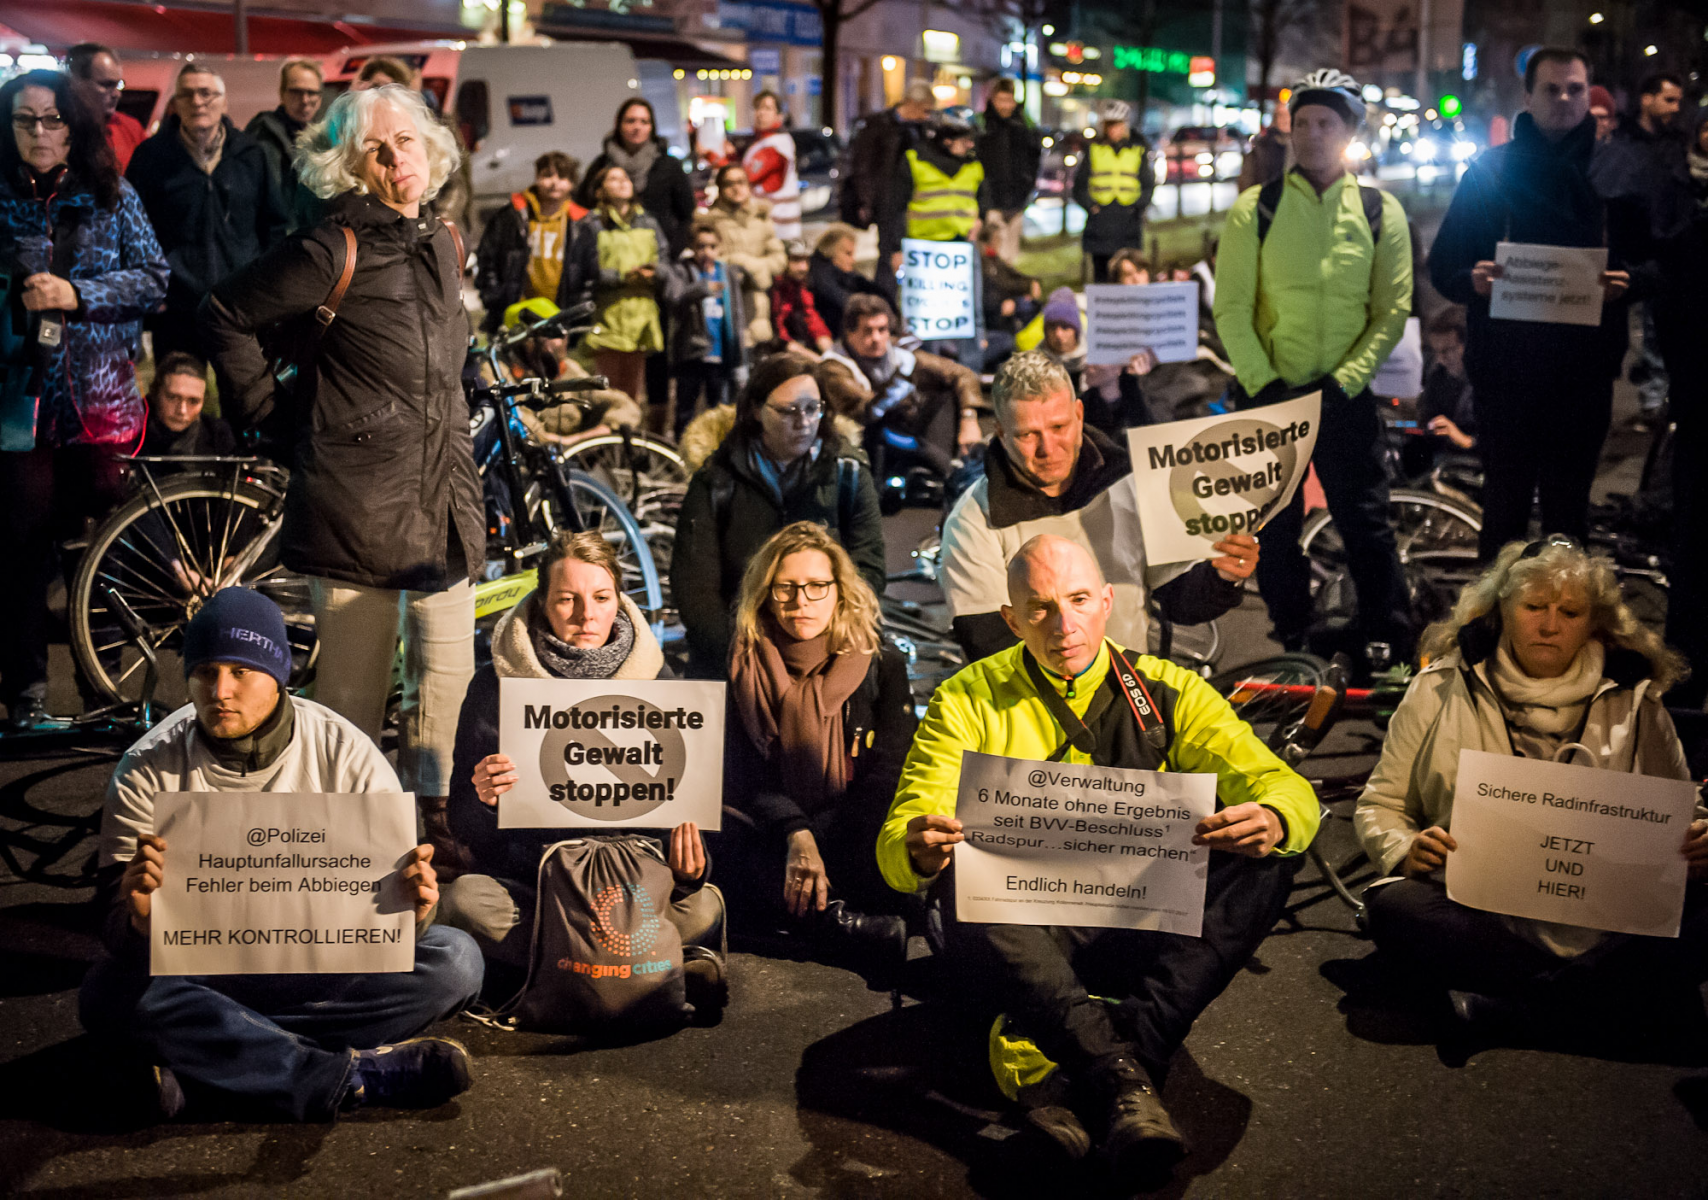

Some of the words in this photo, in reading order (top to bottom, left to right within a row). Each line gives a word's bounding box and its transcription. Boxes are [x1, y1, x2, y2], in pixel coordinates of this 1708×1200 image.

[908, 250, 967, 269] STOP
[908, 316, 968, 332] STOP
[1148, 420, 1310, 470] Motorisierte
[1192, 462, 1282, 499] Gewalt
[1122, 673, 1136, 687] 6D
[1129, 688, 1151, 716] EOS
[524, 704, 704, 730] Motorisierte
[564, 741, 664, 766] Gewalt
[549, 777, 675, 807] stoppen!
[1028, 769, 1146, 797] @Verwaltung
[978, 788, 989, 803] 6
[995, 790, 1059, 810] Monate
[1065, 798, 1108, 815] ohne
[1114, 802, 1191, 820] Ergebnis
[1477, 783, 1538, 804] Sichere
[1542, 792, 1673, 825] Radinfrastruktur
[993, 814, 1025, 829] seit
[247, 828, 326, 847] @Polizei
[1540, 835, 1595, 855] JETZT
[199, 853, 371, 872] Hauptunfallursache
[1545, 858, 1584, 877] UND
[186, 877, 244, 893] Fehler
[250, 876, 292, 893] beim
[298, 877, 381, 896] Abbiegen
[1006, 875, 1068, 893] Endlich
[1073, 879, 1147, 900] handeln!
[1537, 879, 1586, 900] HIER!
[163, 929, 222, 946] MEHR
[228, 928, 402, 945] KONTROLLIEREN!
